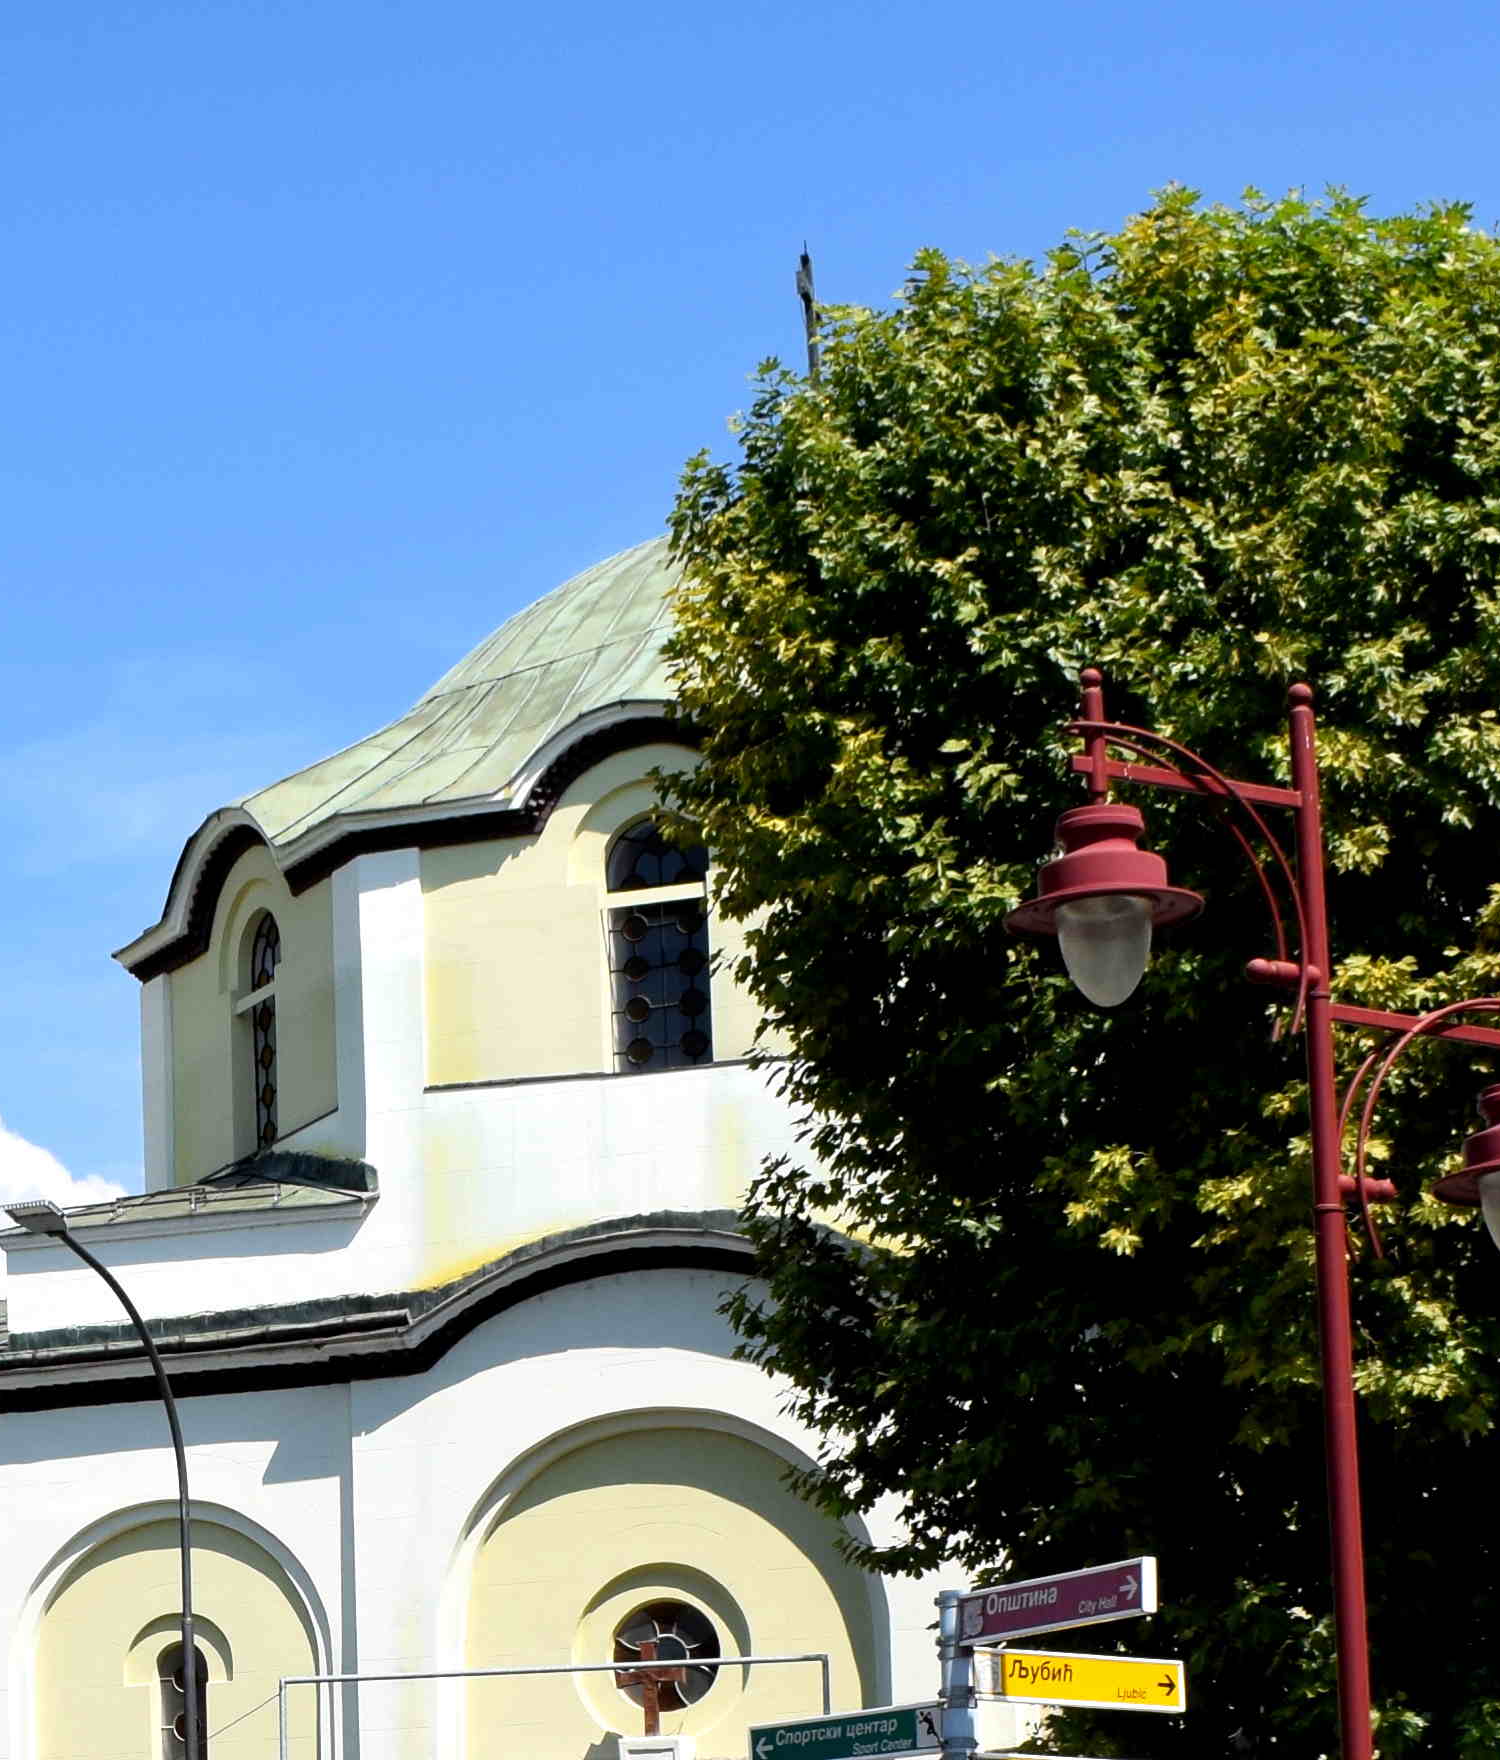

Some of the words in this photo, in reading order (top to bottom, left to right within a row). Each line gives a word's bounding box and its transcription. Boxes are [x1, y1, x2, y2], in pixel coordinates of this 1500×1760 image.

[985, 1586, 1058, 1615] Општина
[1078, 1601, 1097, 1615] City
[1098, 1595, 1118, 1611] Hall
[1009, 1659, 1073, 1684] Љубић
[775, 1725, 842, 1747] Спортски
[846, 1718, 899, 1739] центар
[852, 1742, 879, 1755] Sport
[879, 1737, 913, 1752] Center
